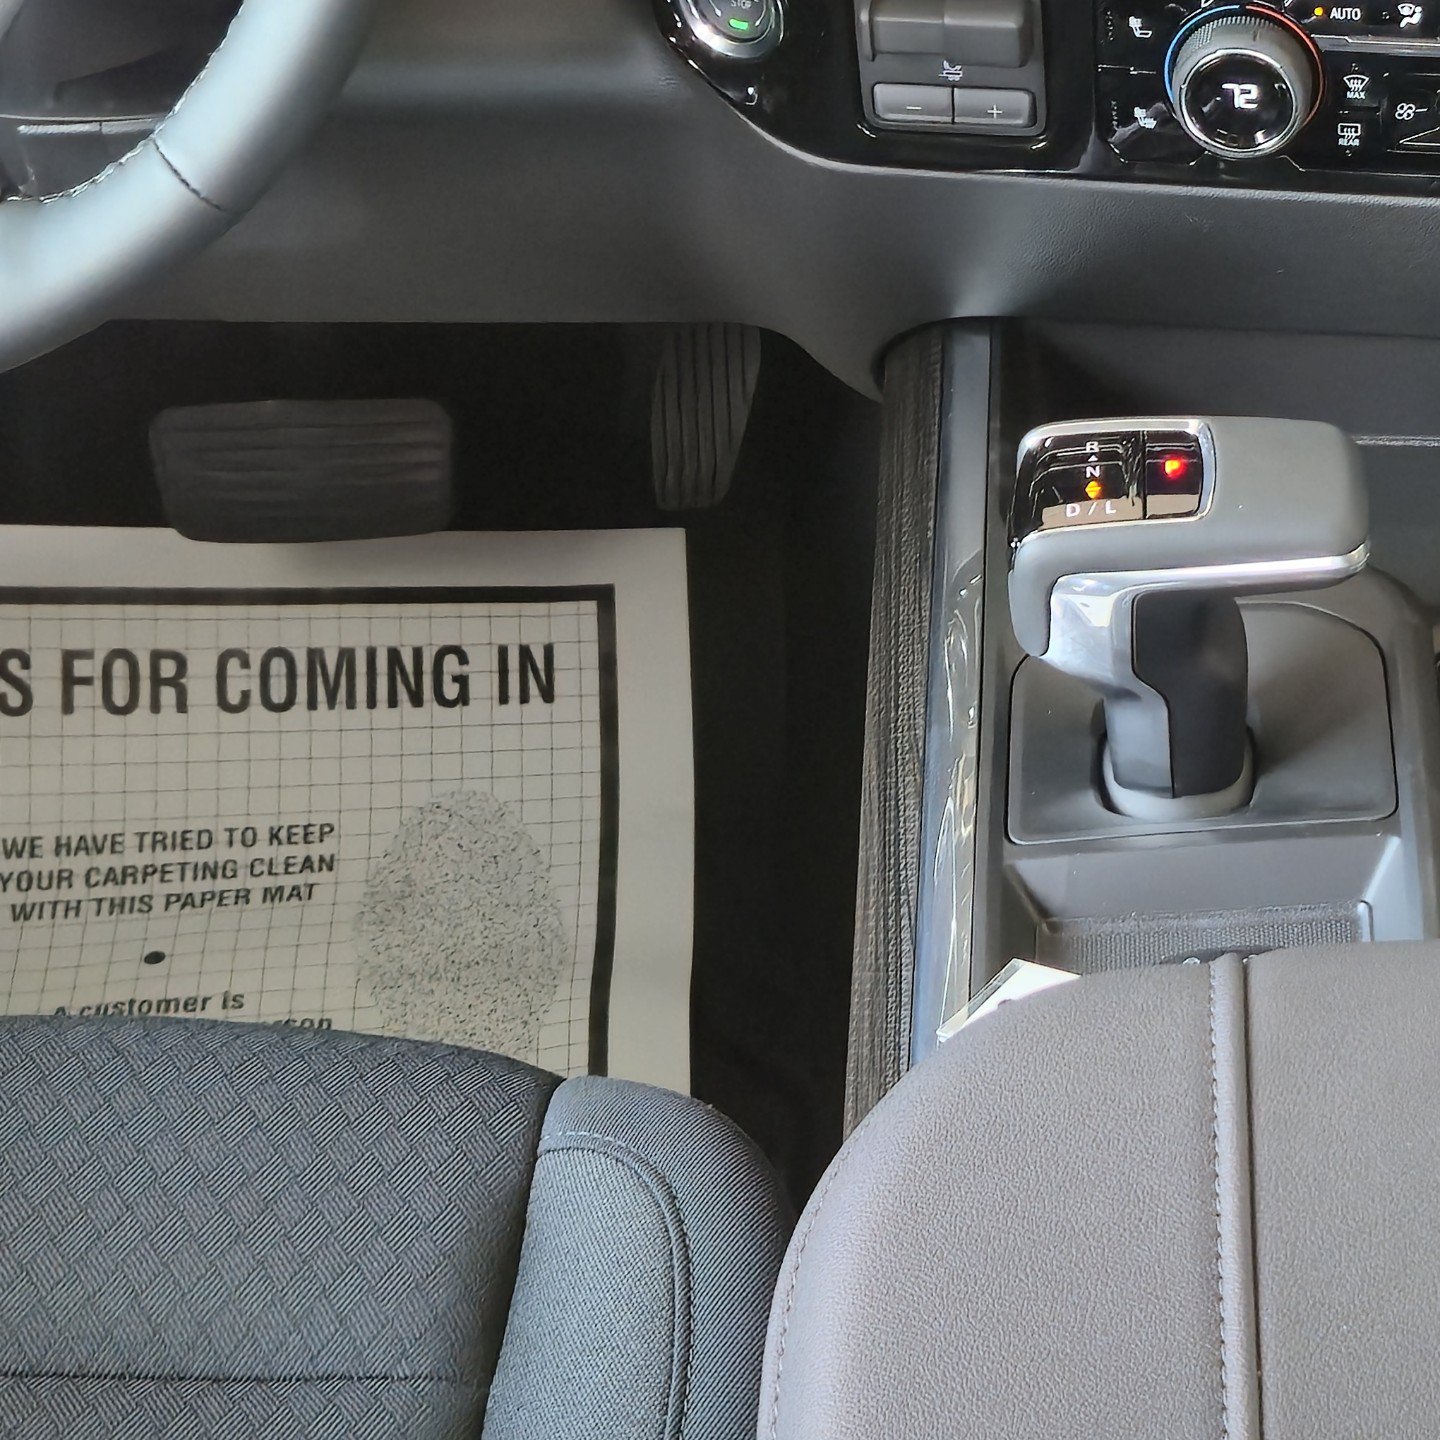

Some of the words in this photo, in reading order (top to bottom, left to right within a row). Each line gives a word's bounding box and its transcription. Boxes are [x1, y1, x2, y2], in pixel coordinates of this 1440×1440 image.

[1330, 7, 1361, 21] AUTO
[1222, 83, 1259, 109] 72
[1346, 91, 1366, 100] MAX
[1085, 441, 1100, 453] R
[1085, 464, 1100, 478] N
[1066, 503, 1080, 517] D
[1105, 500, 1116, 515] L
[61, 648, 188, 715] FOR
[215, 643, 471, 713] COMING
[497, 642, 556, 705] IN
[2, 836, 43, 860] WE
[54, 832, 126, 857] HAVE
[133, 828, 213, 854] TRIED
[223, 826, 258, 849] TO
[268, 822, 335, 846] KEEP
[84, 858, 238, 888] CARPETING
[249, 853, 335, 878] CLEAN
[10, 898, 82, 923] WITH
[92, 894, 153, 917] THIS
[164, 887, 251, 912] PAPER
[262, 882, 319, 905] MAT
[221, 991, 245, 1010] is
